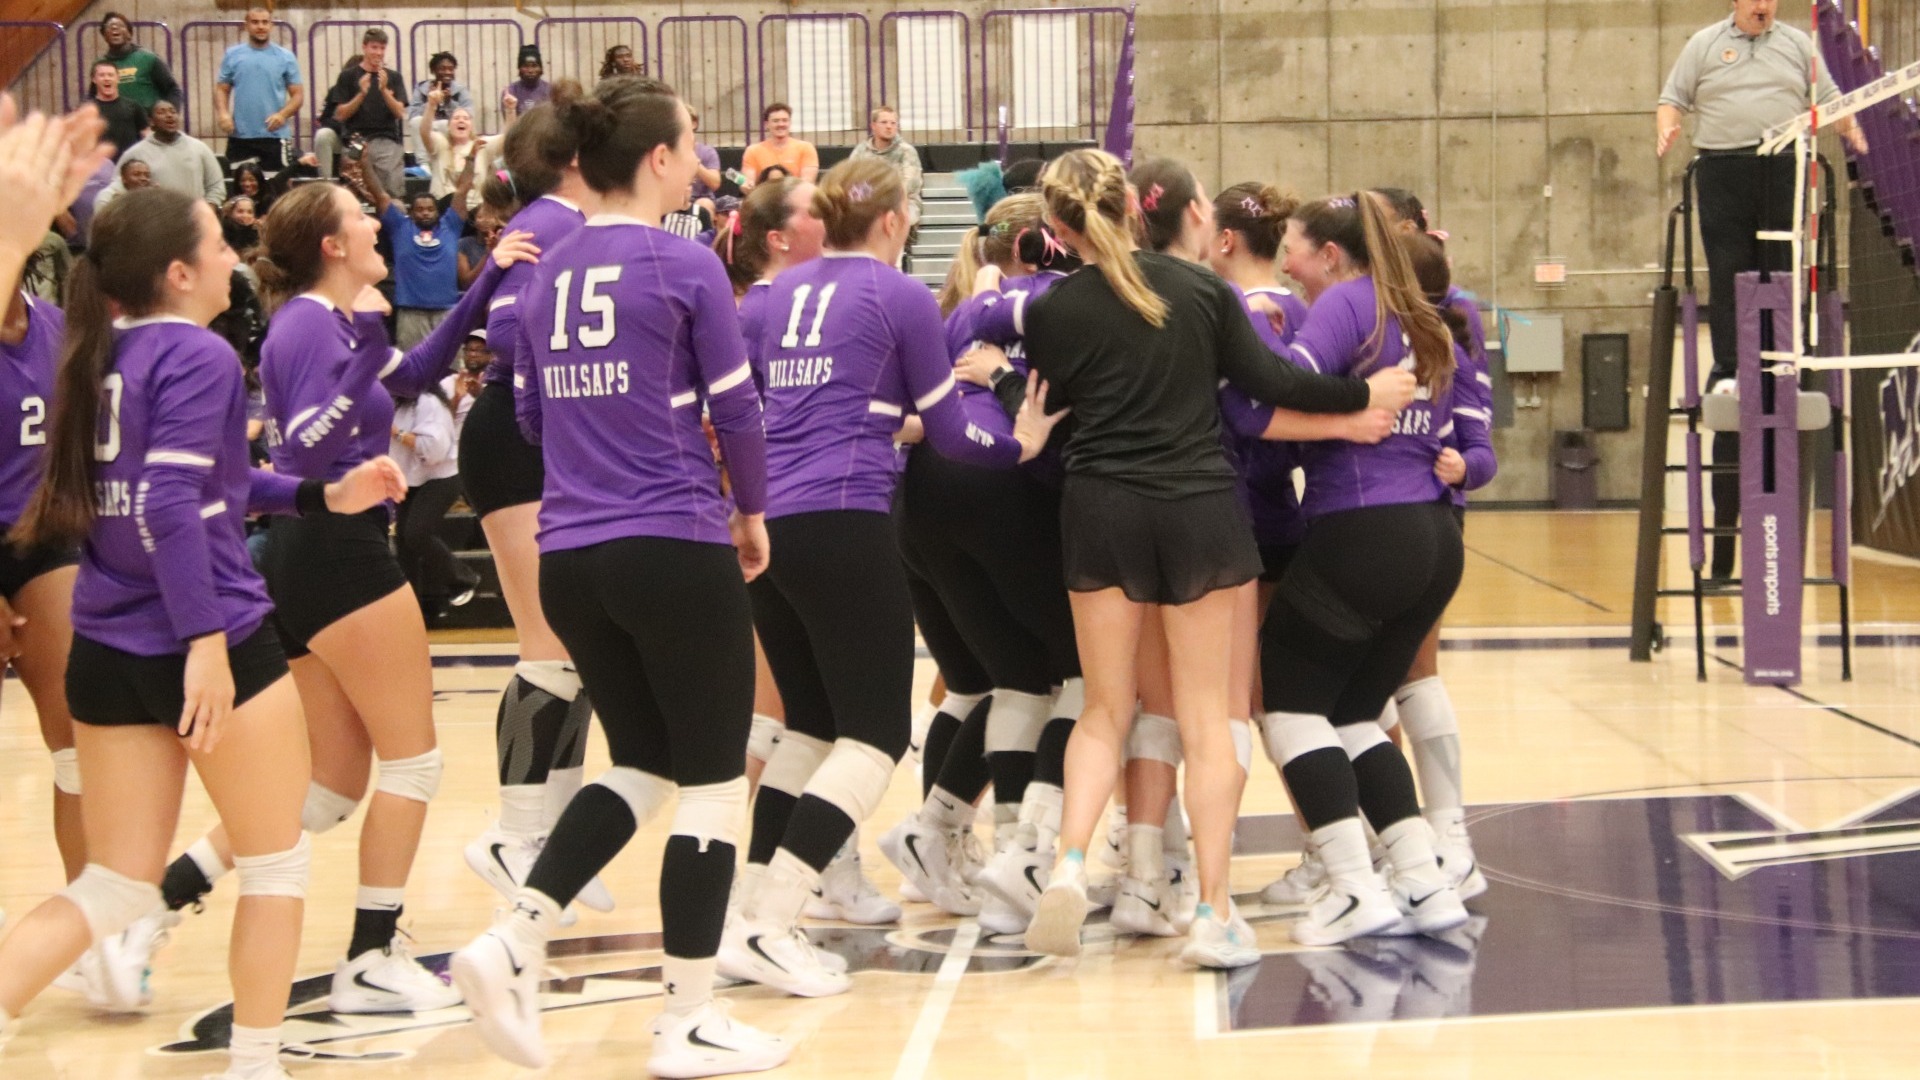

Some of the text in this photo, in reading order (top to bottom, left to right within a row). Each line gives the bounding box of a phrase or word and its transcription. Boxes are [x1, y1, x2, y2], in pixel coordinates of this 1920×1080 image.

[550, 265, 622, 351] 15
[781, 281, 838, 348] 11
[543, 360, 629, 399] MILLSAPS
[768, 356, 833, 389] MILLSAPS
[20, 396, 47, 447] 2
[298, 394, 355, 449] MAJORS
[1762, 514, 1782, 616] sports imports
